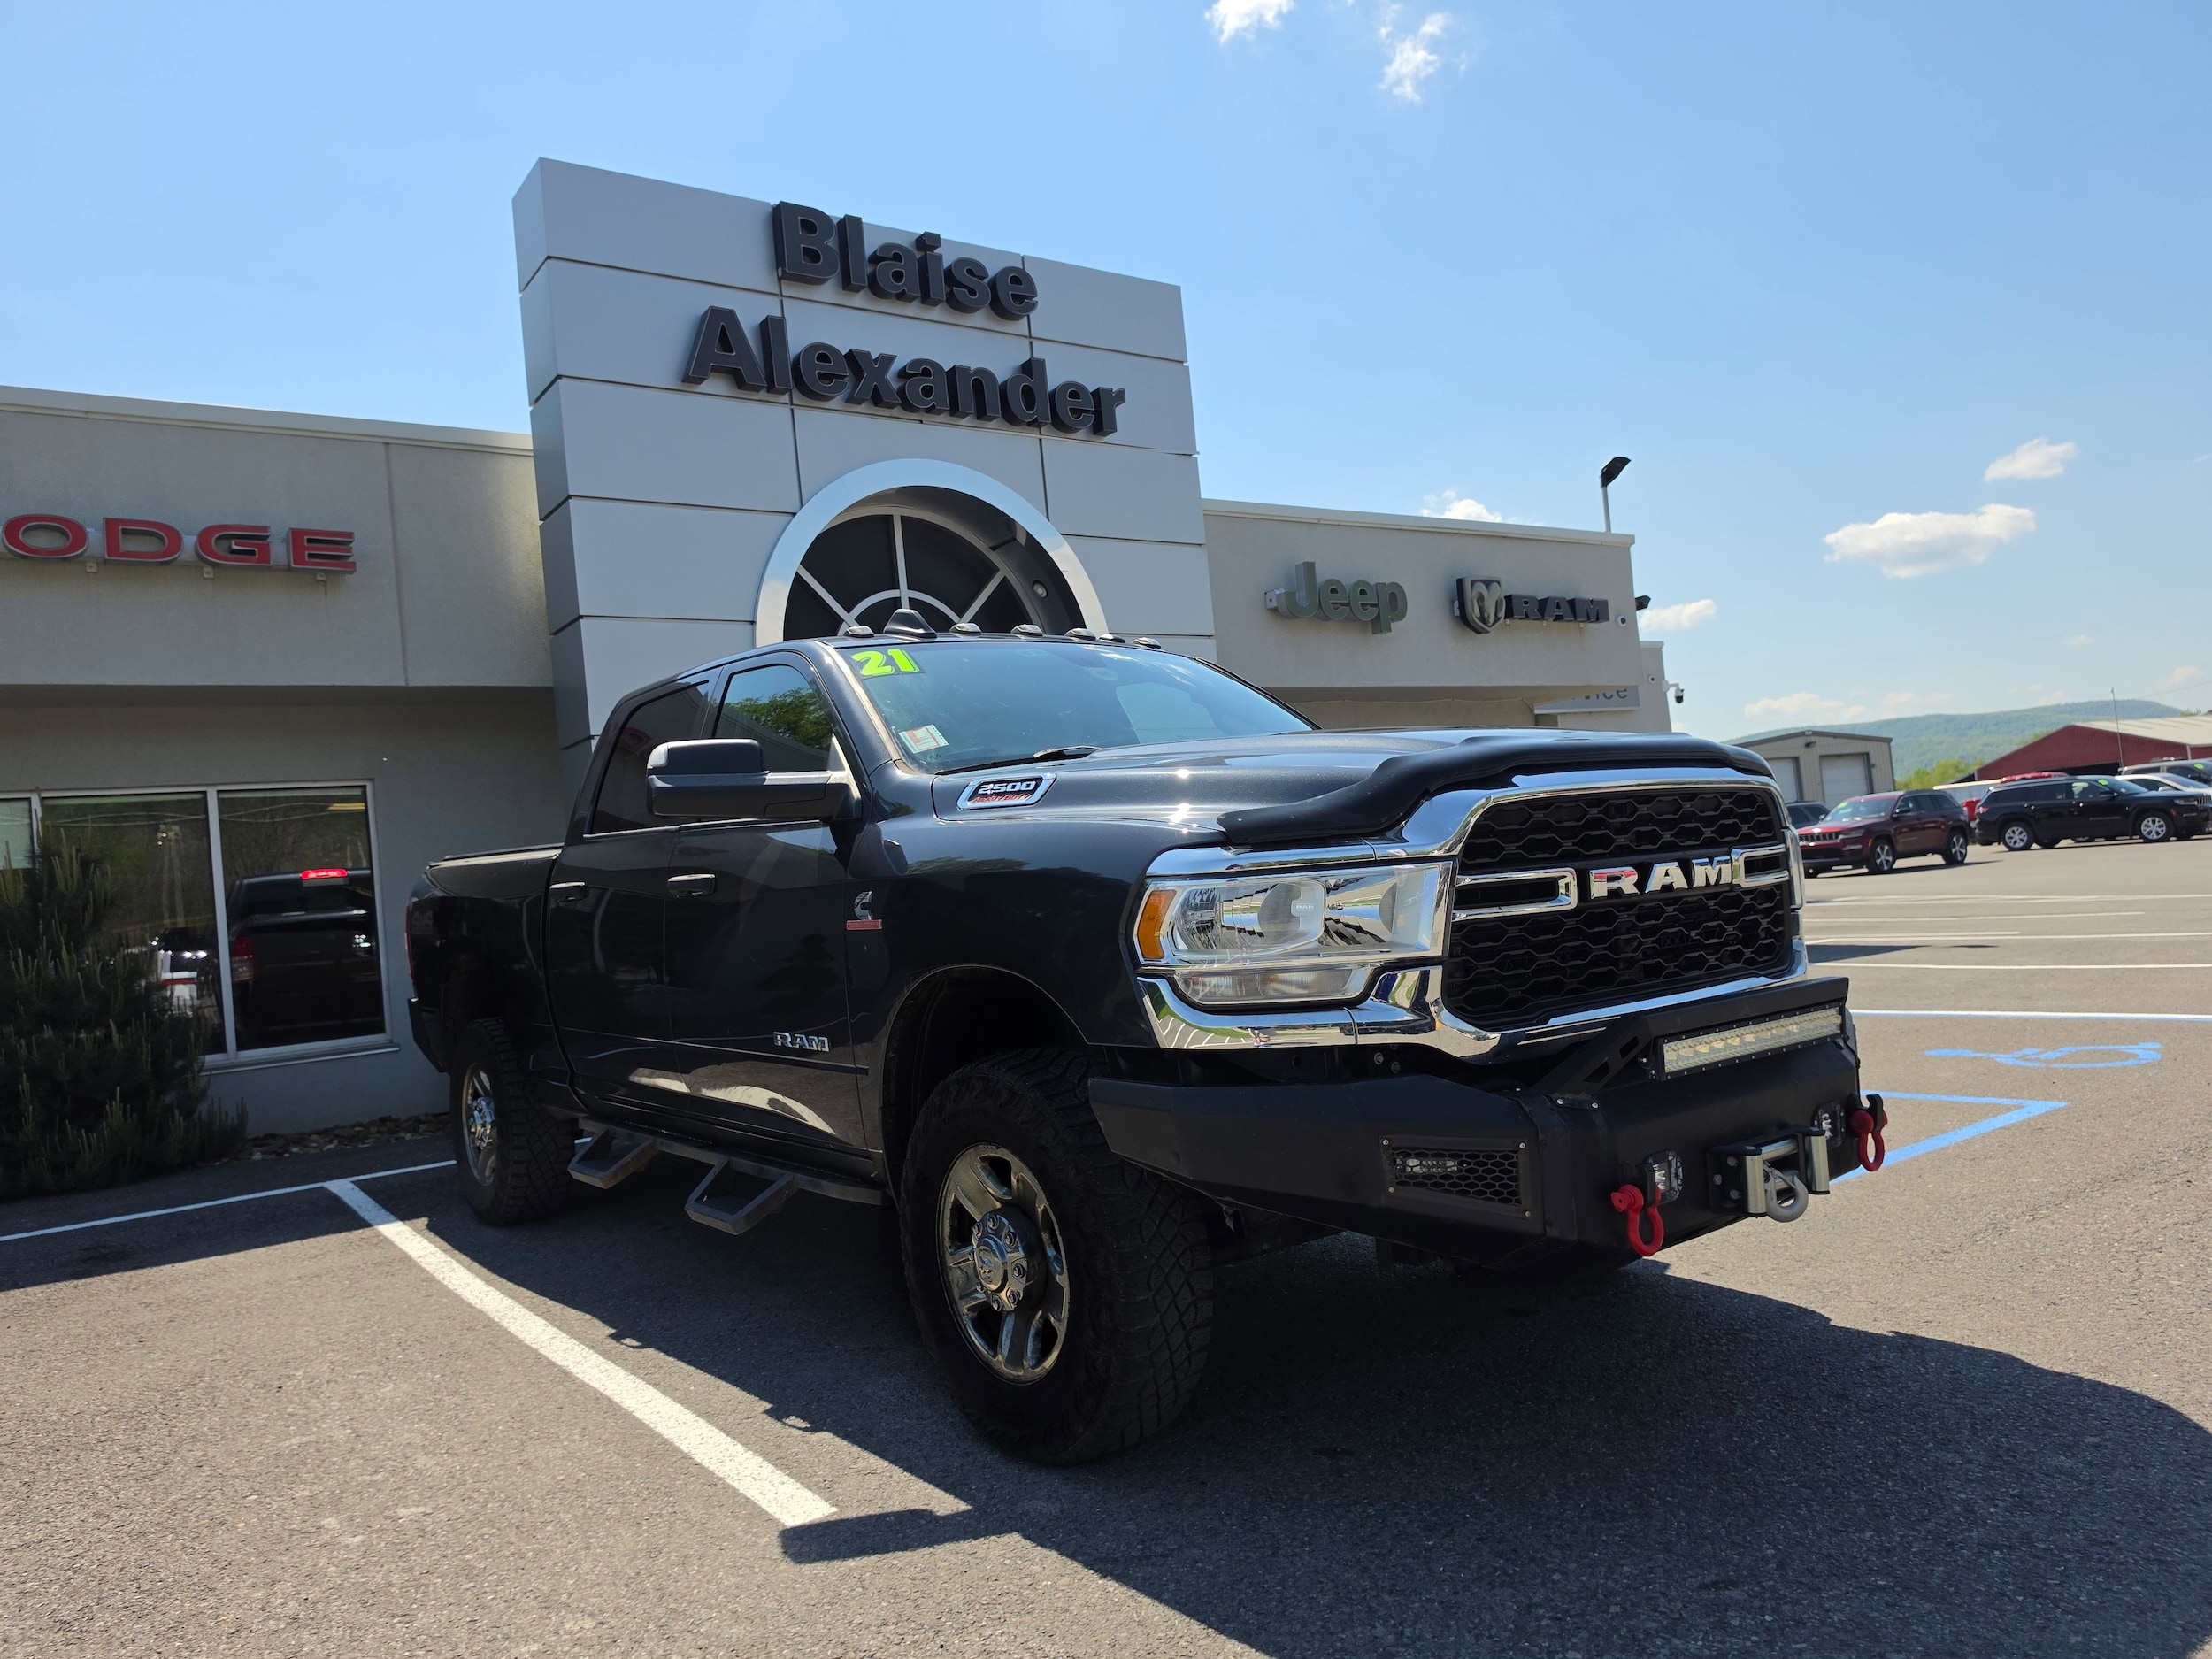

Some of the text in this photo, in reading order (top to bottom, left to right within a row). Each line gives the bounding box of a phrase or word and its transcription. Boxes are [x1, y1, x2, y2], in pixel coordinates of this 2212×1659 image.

[772, 201, 1039, 321] Blaise
[681, 305, 1126, 437] Alexander
[2, 513, 357, 574] ODGE
[1276, 561, 1408, 635] Jeep
[1505, 594, 1610, 623] RAM
[851, 649, 920, 677] 21
[978, 780, 1036, 795] 2500
[1590, 856, 1733, 899] RAM
[772, 1031, 830, 1053] RAM
